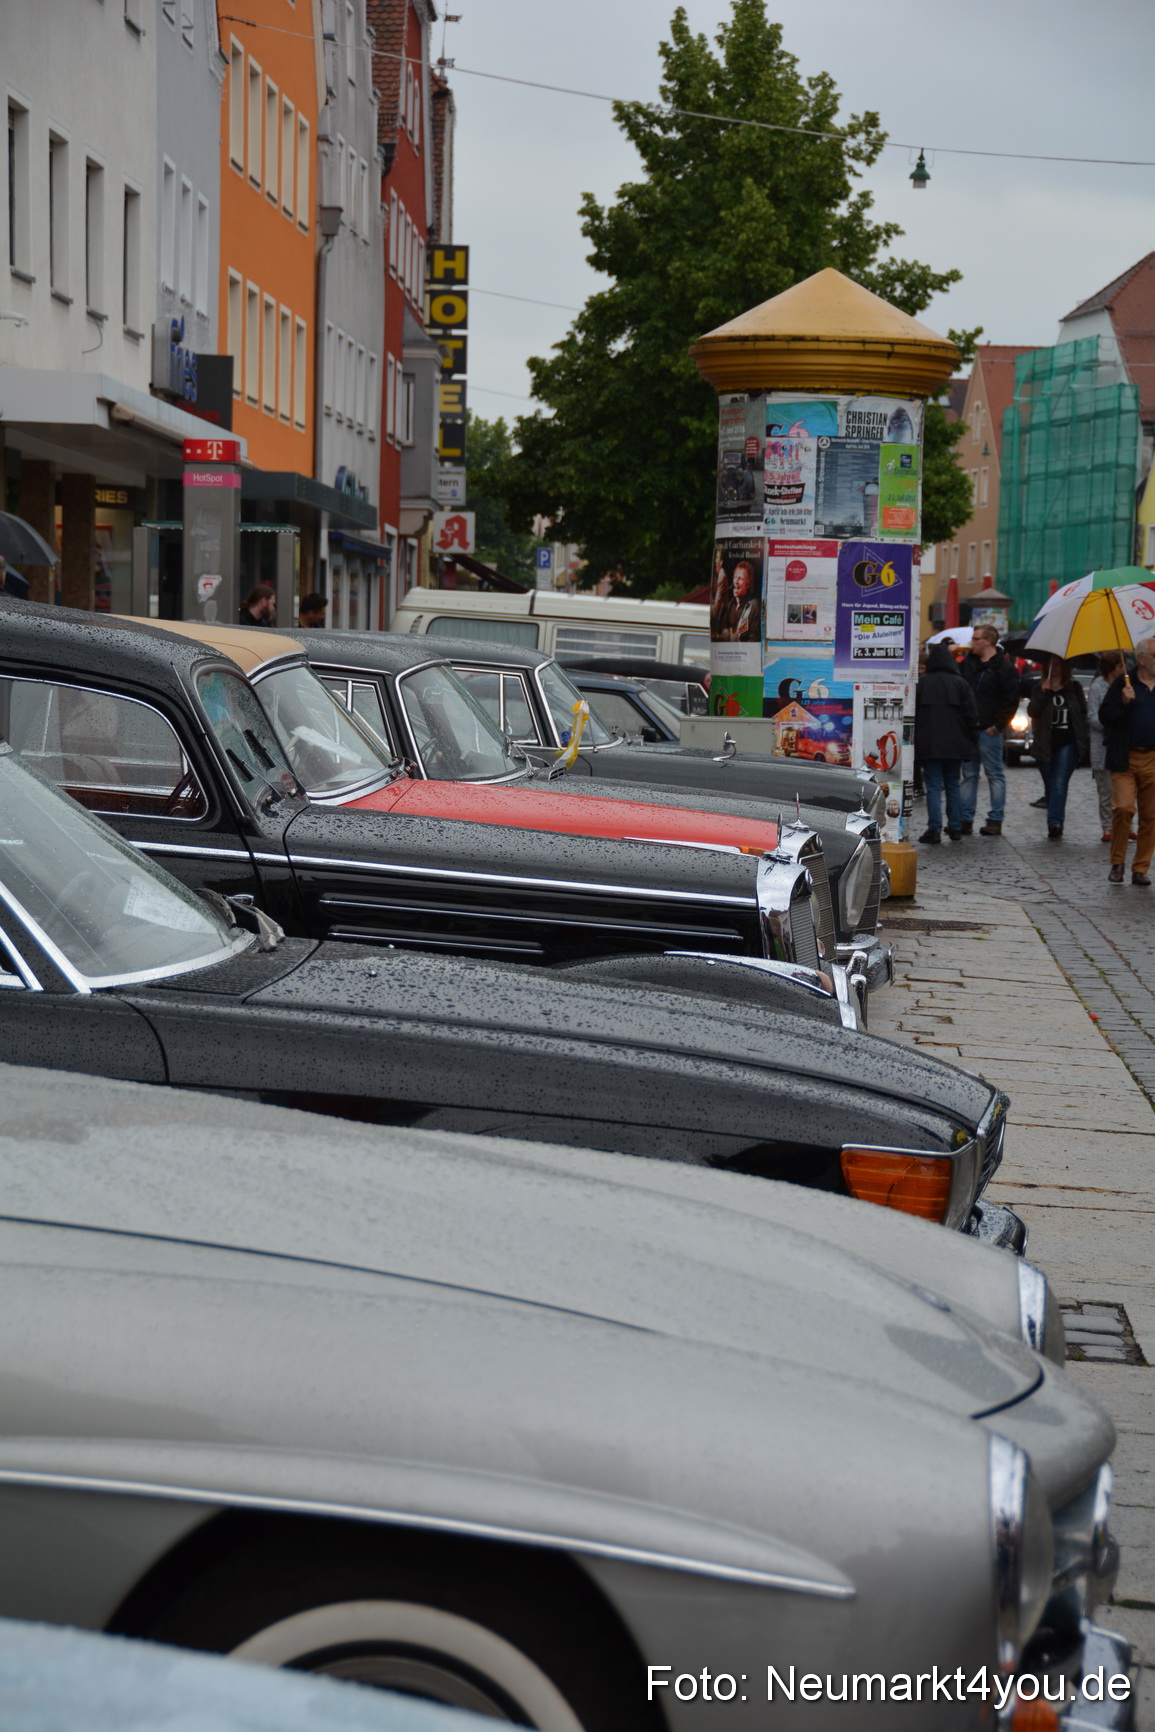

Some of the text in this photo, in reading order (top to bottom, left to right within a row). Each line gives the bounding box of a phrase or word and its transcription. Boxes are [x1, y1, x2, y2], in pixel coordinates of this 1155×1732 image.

[431, 250, 467, 456] HOTEL
[846, 411, 888, 426] CHRISTIAN
[845, 425, 884, 439] SPRINGER
[193, 473, 223, 487] HotSpot
[438, 479, 459, 487] tern
[729, 540, 761, 549] Garfunkel
[541, 550, 549, 567] P
[853, 561, 895, 587] G6
[854, 614, 902, 624] Mein Café
[854, 648, 863, 656] Fr.
[864, 648, 871, 656] 3.
[872, 648, 886, 656] Juni
[895, 648, 904, 656] Uhr
